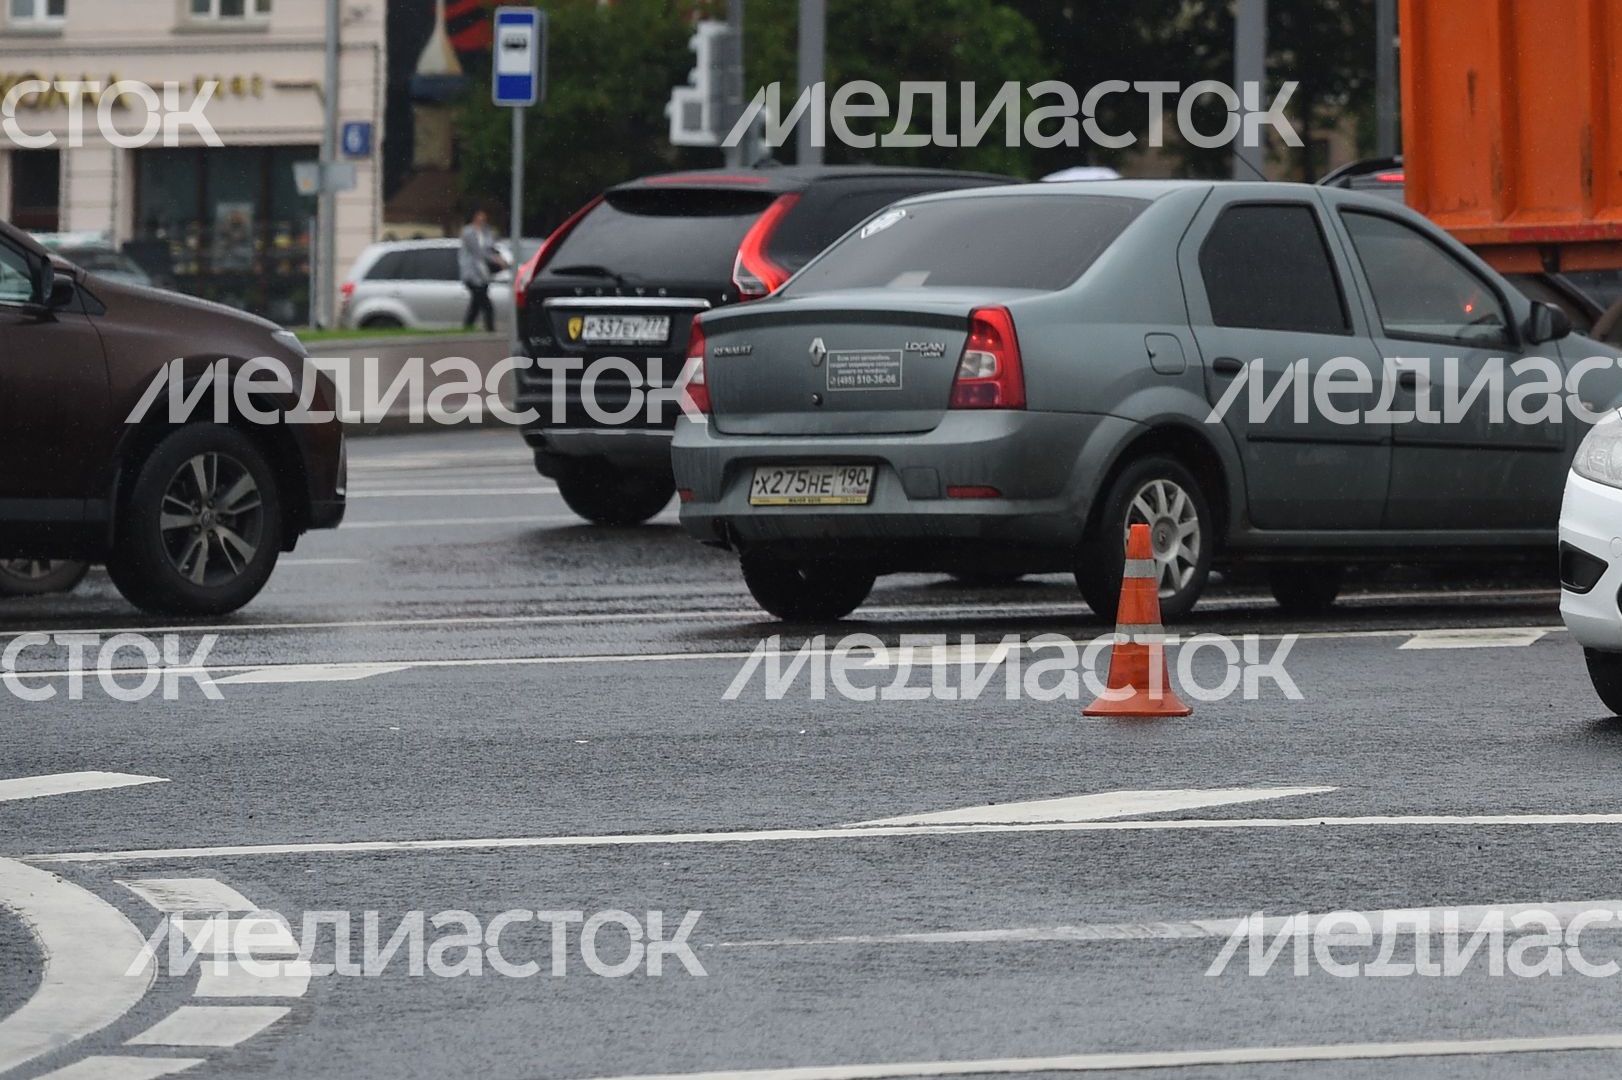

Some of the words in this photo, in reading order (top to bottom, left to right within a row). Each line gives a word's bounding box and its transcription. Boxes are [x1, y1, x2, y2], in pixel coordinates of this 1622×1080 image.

[713, 344, 752, 356] RENAULT
[905, 341, 945, 352] LOGAN
[839, 468, 867, 487] 190
